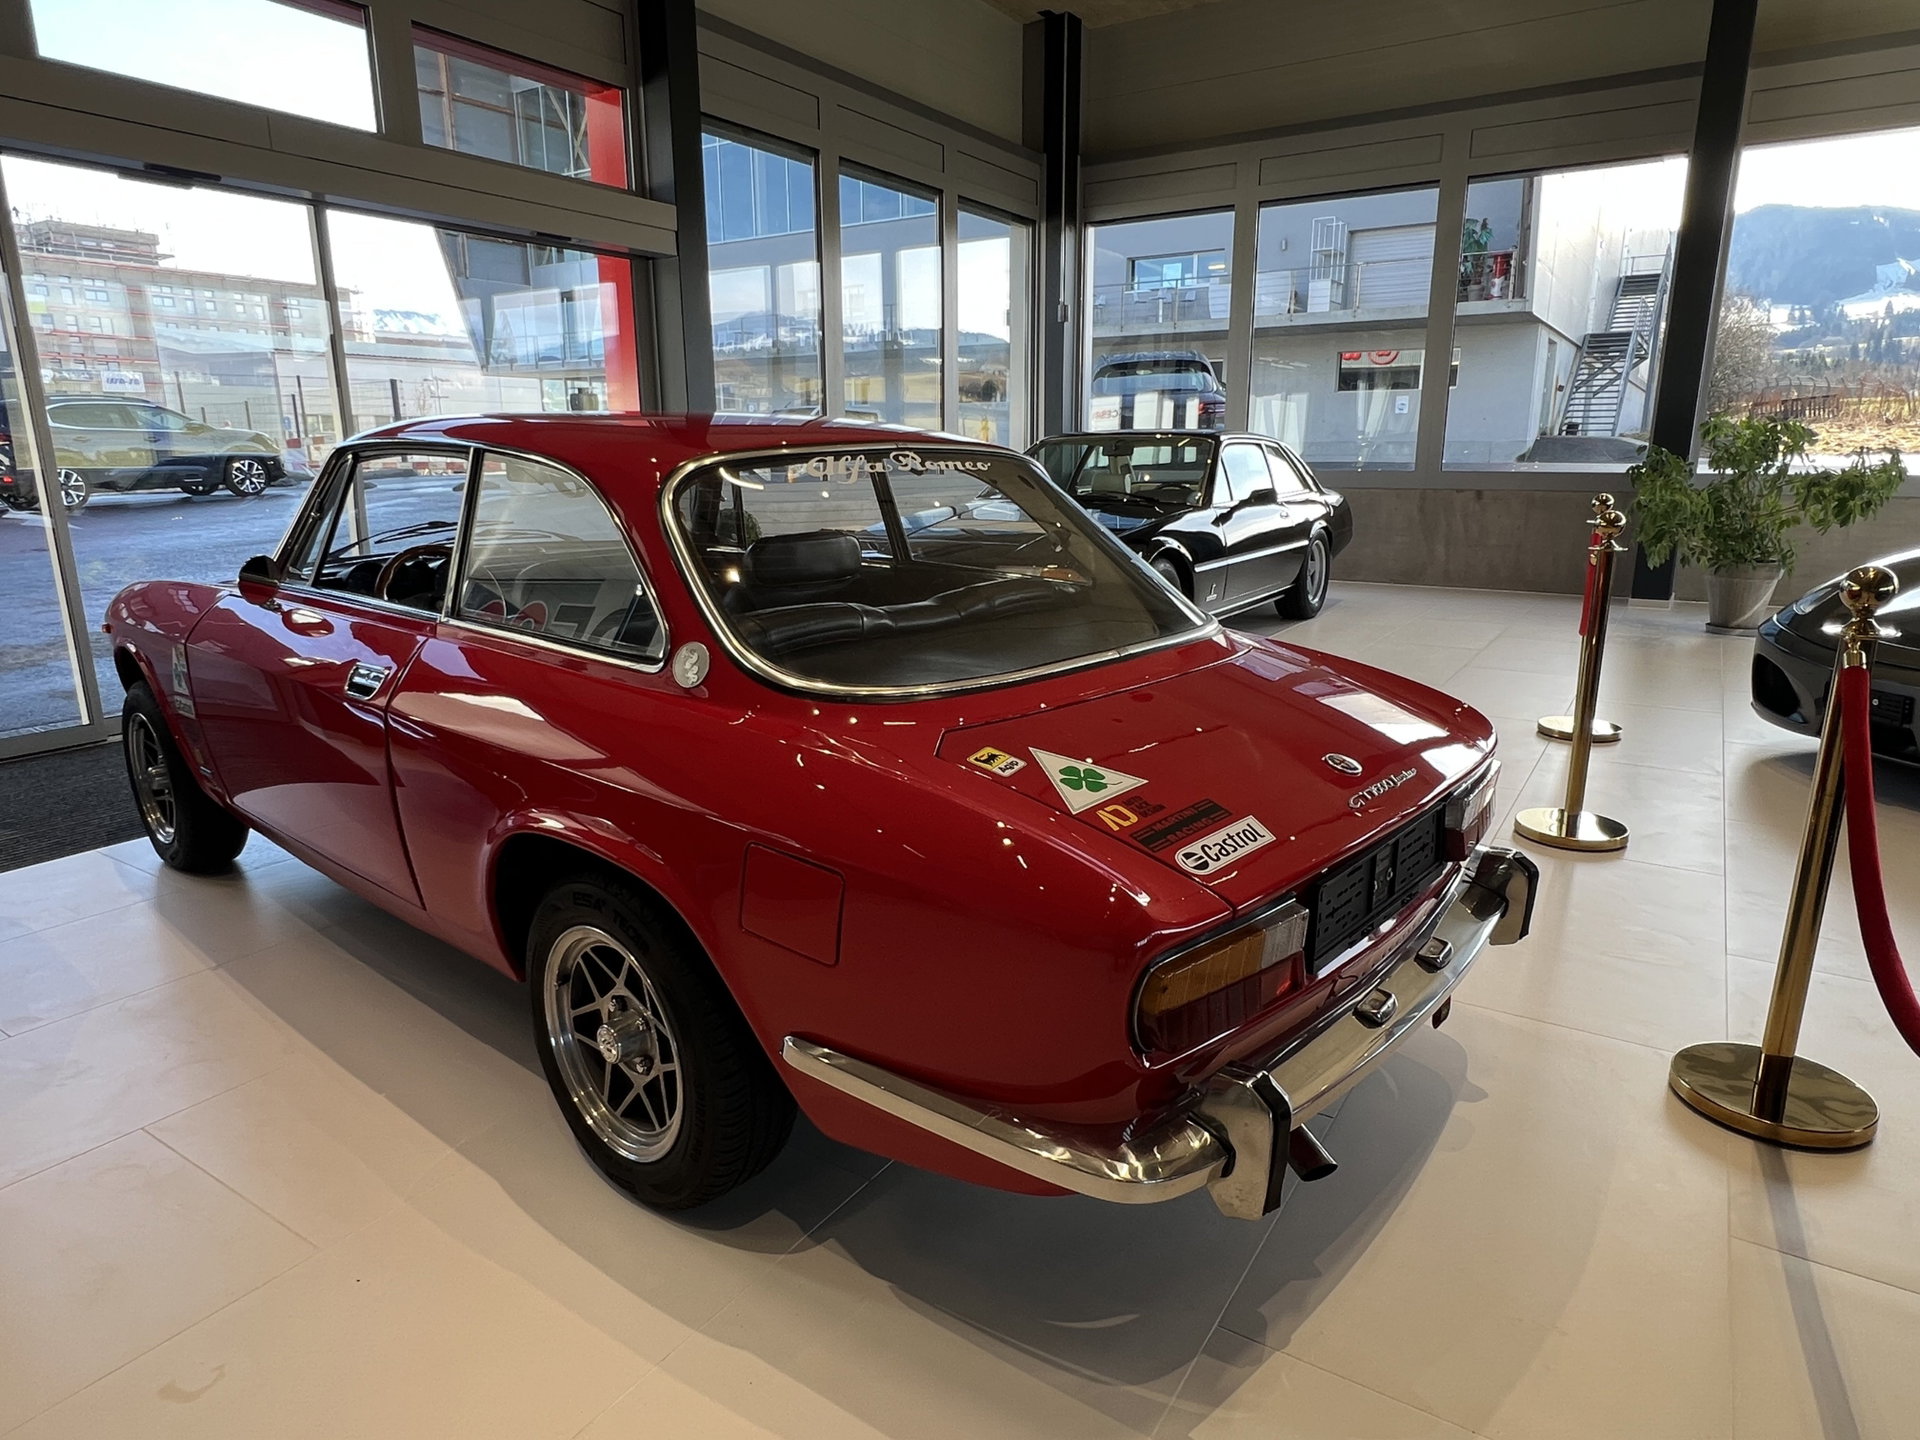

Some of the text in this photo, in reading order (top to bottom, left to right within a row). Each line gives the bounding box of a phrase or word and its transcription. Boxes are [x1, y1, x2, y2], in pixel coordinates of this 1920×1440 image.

[805, 450, 992, 484] Alfa Romeo
[998, 760, 1019, 773] Agip
[1150, 806, 1199, 833] MARTINI
[1166, 818, 1213, 844] RACING
[1200, 823, 1266, 863] Castrol
